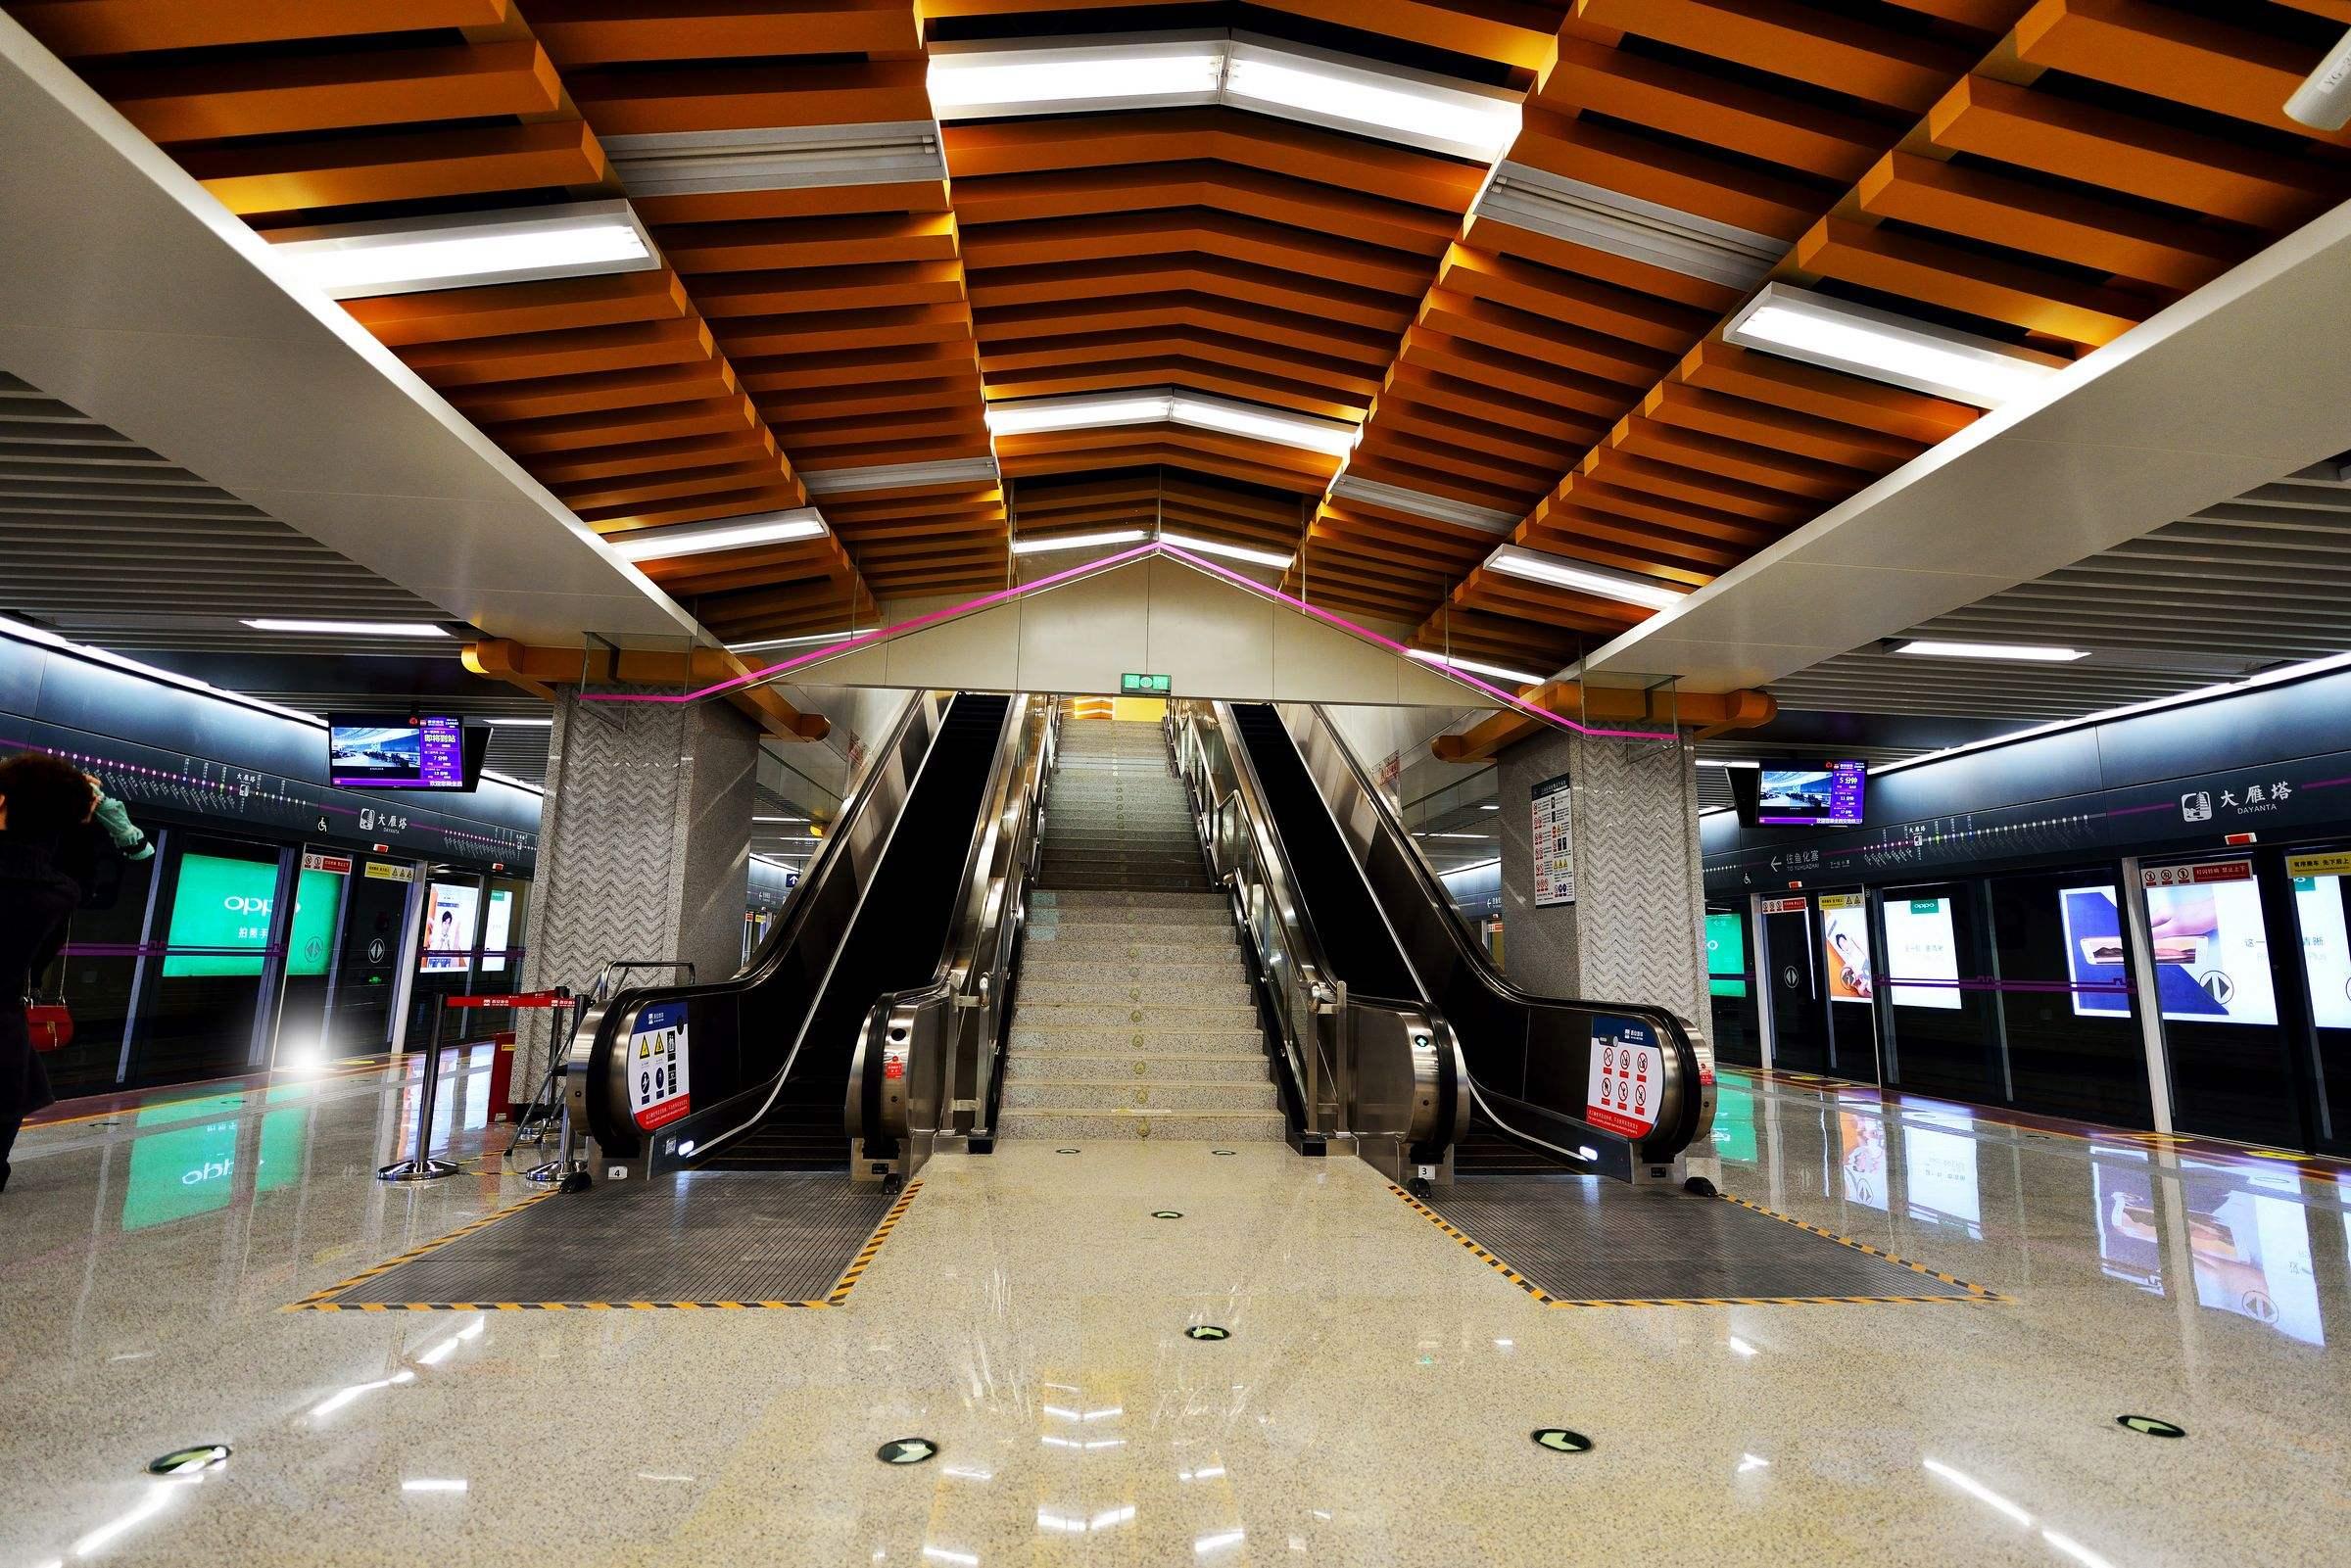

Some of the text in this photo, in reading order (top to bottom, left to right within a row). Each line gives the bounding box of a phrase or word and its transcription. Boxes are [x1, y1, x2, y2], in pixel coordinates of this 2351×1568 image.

[2220, 781, 2293, 808] 大雁塔
[2237, 804, 2278, 815] DAYANTA
[377, 813, 408, 830] 大雁塔
[1786, 850, 1819, 865] 往鱼化寨
[223, 896, 301, 917] opp
[1421, 1166, 1427, 1175] 3
